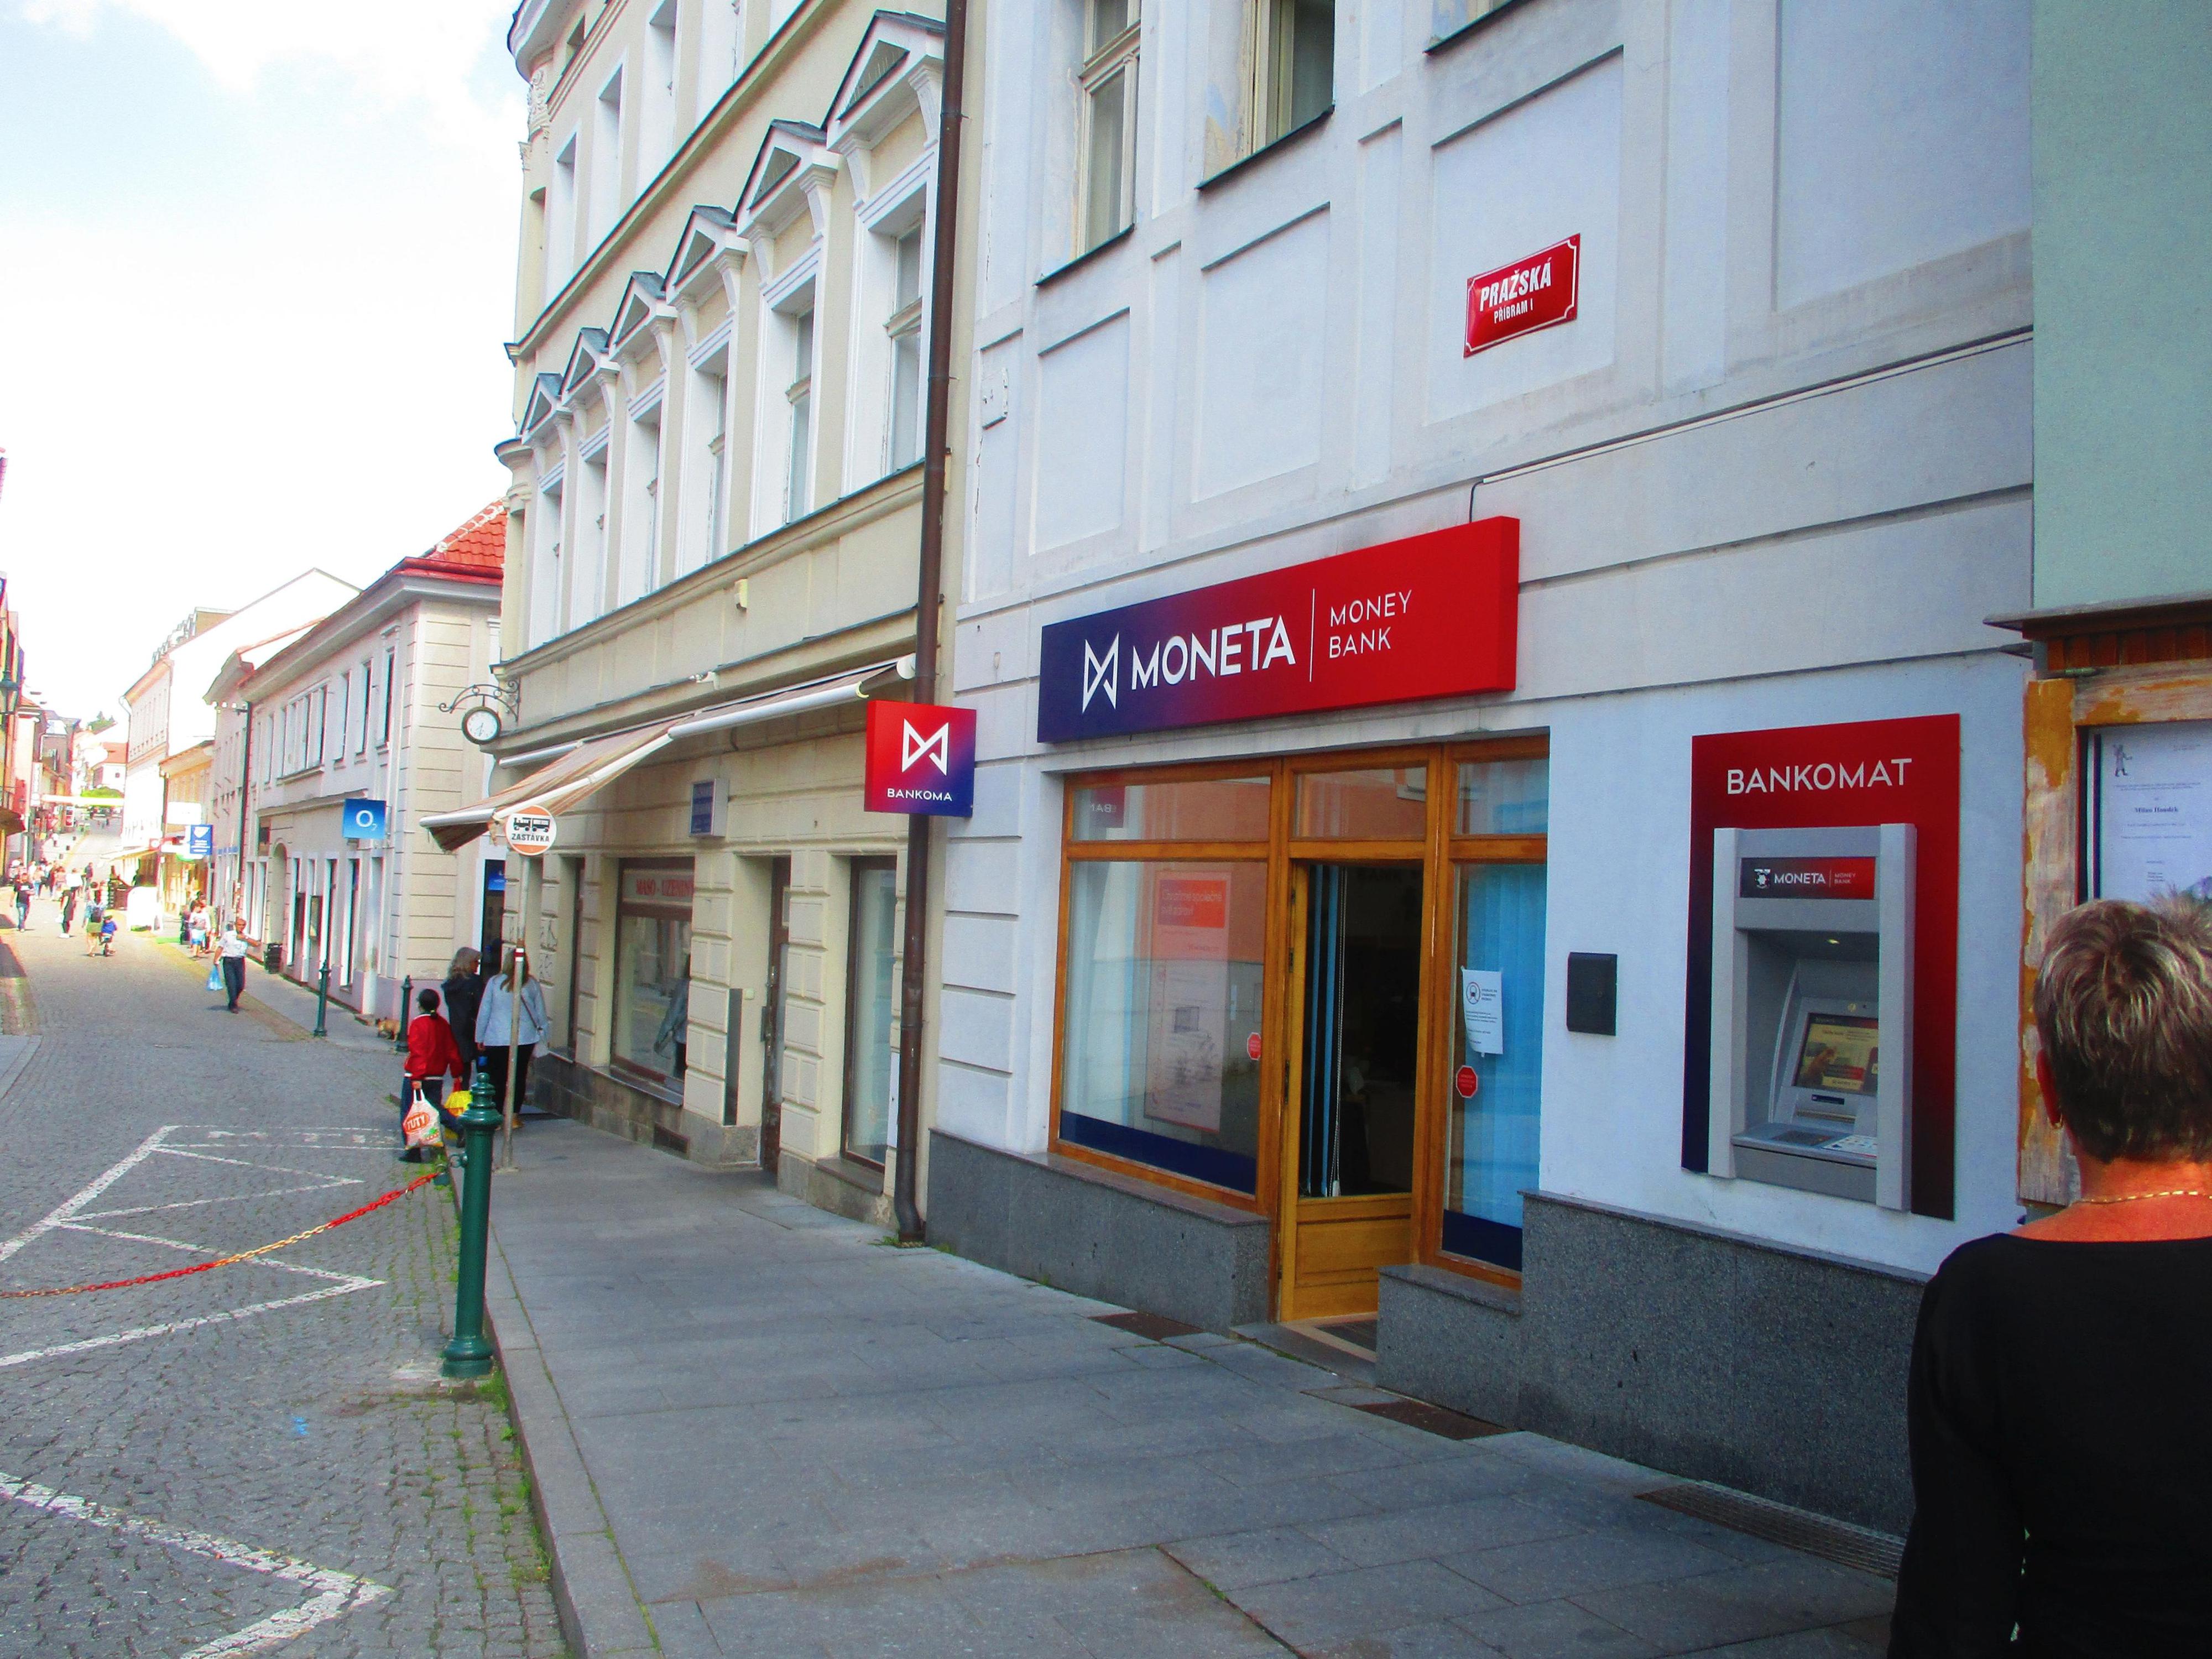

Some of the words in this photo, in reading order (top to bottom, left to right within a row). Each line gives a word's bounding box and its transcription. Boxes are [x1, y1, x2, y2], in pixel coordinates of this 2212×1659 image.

[1479, 257, 1552, 312] PRAŽSKÁ
[1530, 298, 1533, 311] I
[1330, 589, 1412, 627] MONEY
[1131, 614, 1296, 690] MONETA
[1329, 626, 1391, 659] BANK
[1726, 758, 1912, 795] BANKOMAT
[886, 788, 953, 801] BANKOMA
[511, 833, 550, 842] ZASTÁVKA
[1774, 873, 1826, 884] MONETA
[406, 1114, 425, 1130] TUTY
